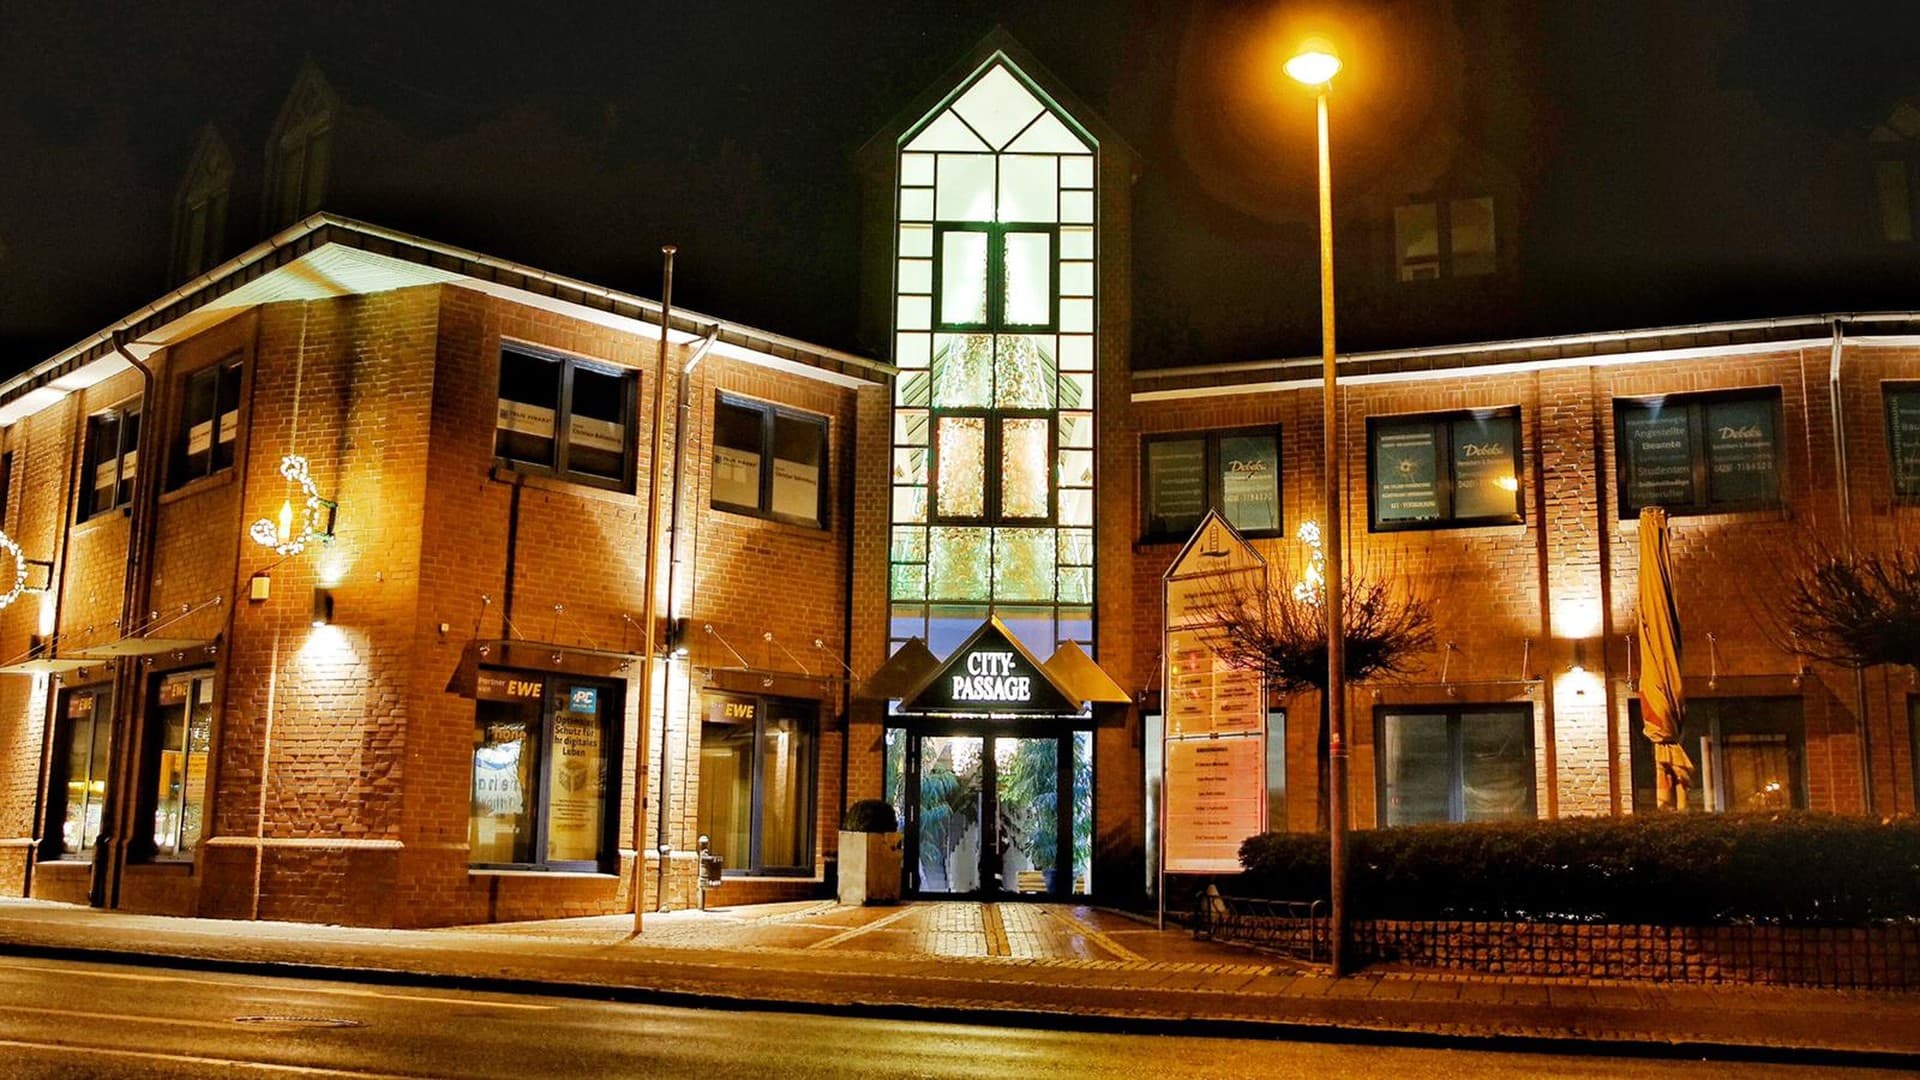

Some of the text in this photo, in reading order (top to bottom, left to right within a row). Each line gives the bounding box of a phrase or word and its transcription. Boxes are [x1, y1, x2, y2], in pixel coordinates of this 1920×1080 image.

[967, 651, 1016, 676] CITY-
[507, 680, 542, 698] EWE
[952, 676, 1031, 701] PASSAGE
[725, 703, 754, 719] EWE
[555, 725, 581, 736] Schutz
[562, 747, 586, 757] Leben
